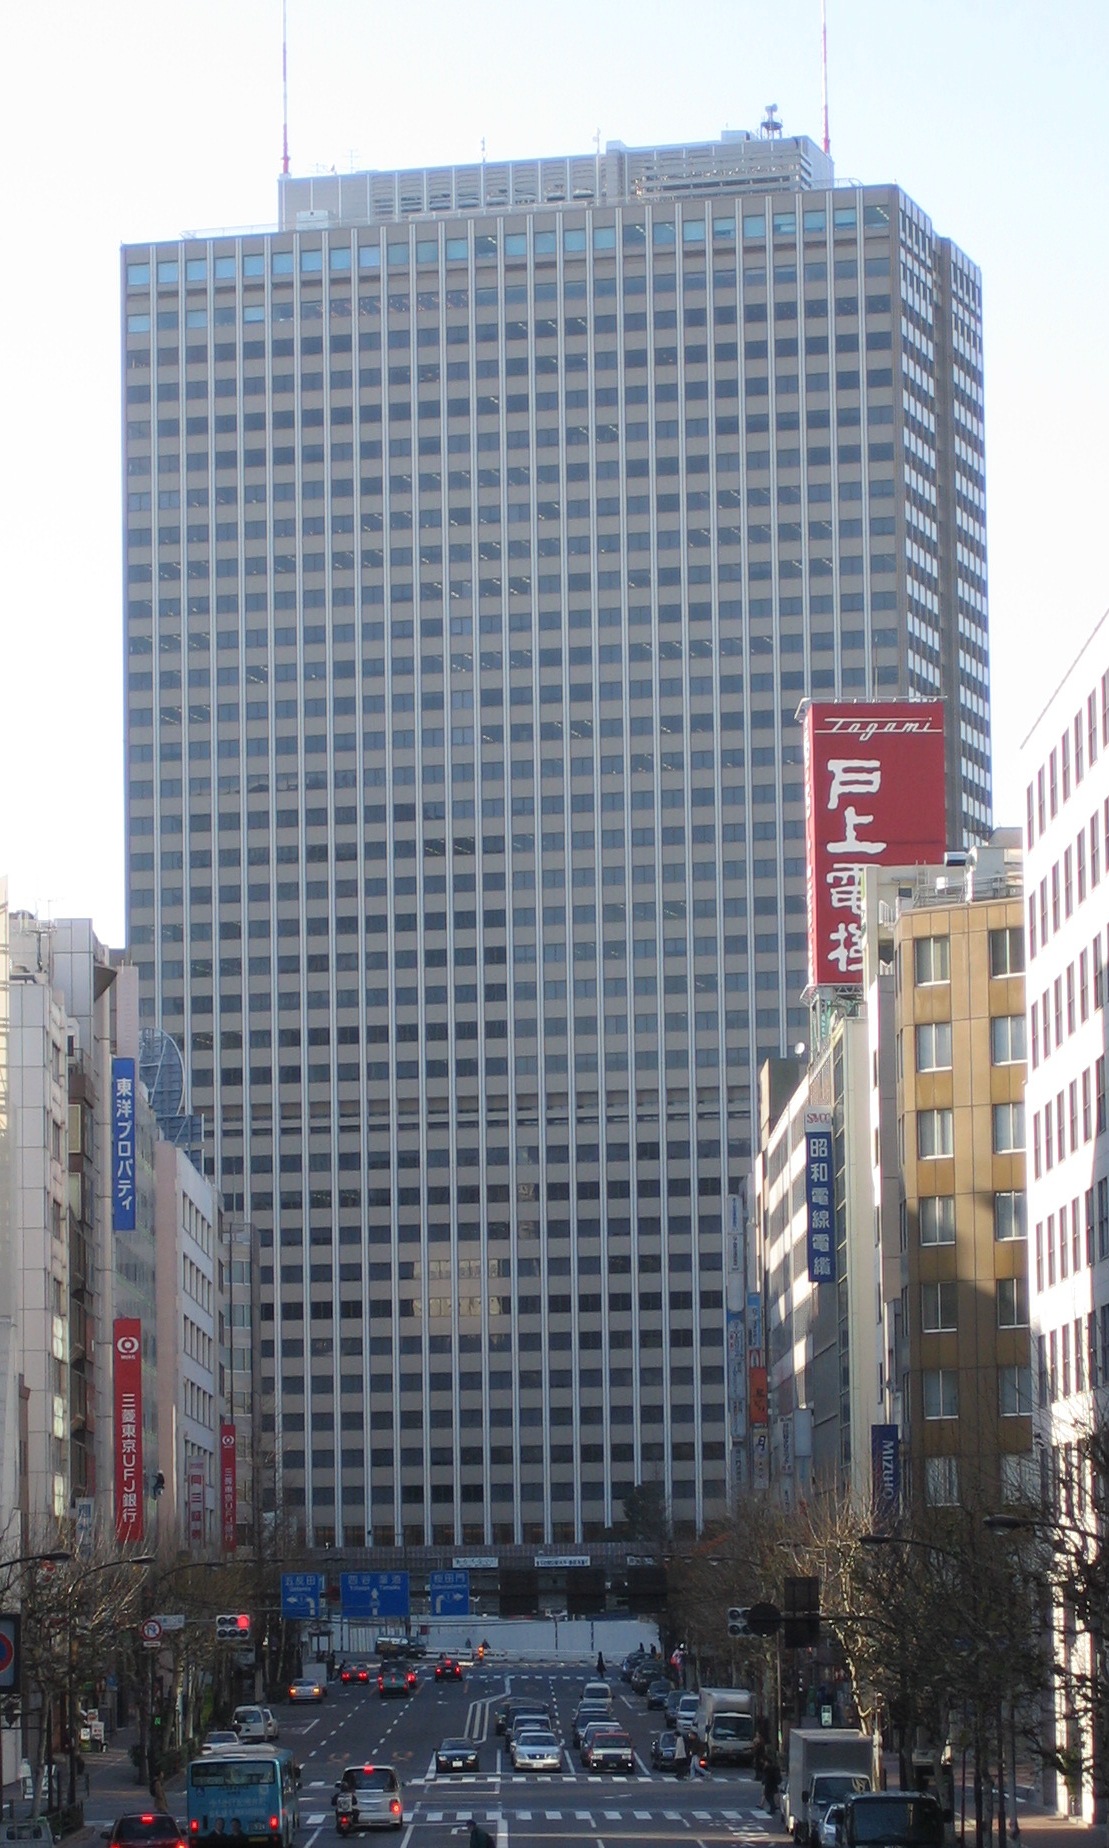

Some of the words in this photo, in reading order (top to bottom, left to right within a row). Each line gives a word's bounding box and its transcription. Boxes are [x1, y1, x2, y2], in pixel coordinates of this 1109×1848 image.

[116, 1077, 133, 1211] 東洋プロパティ
[121, 1393, 138, 1524] 三菱東京UFJ銀行
[882, 1440, 895, 1500] MIZUHO
